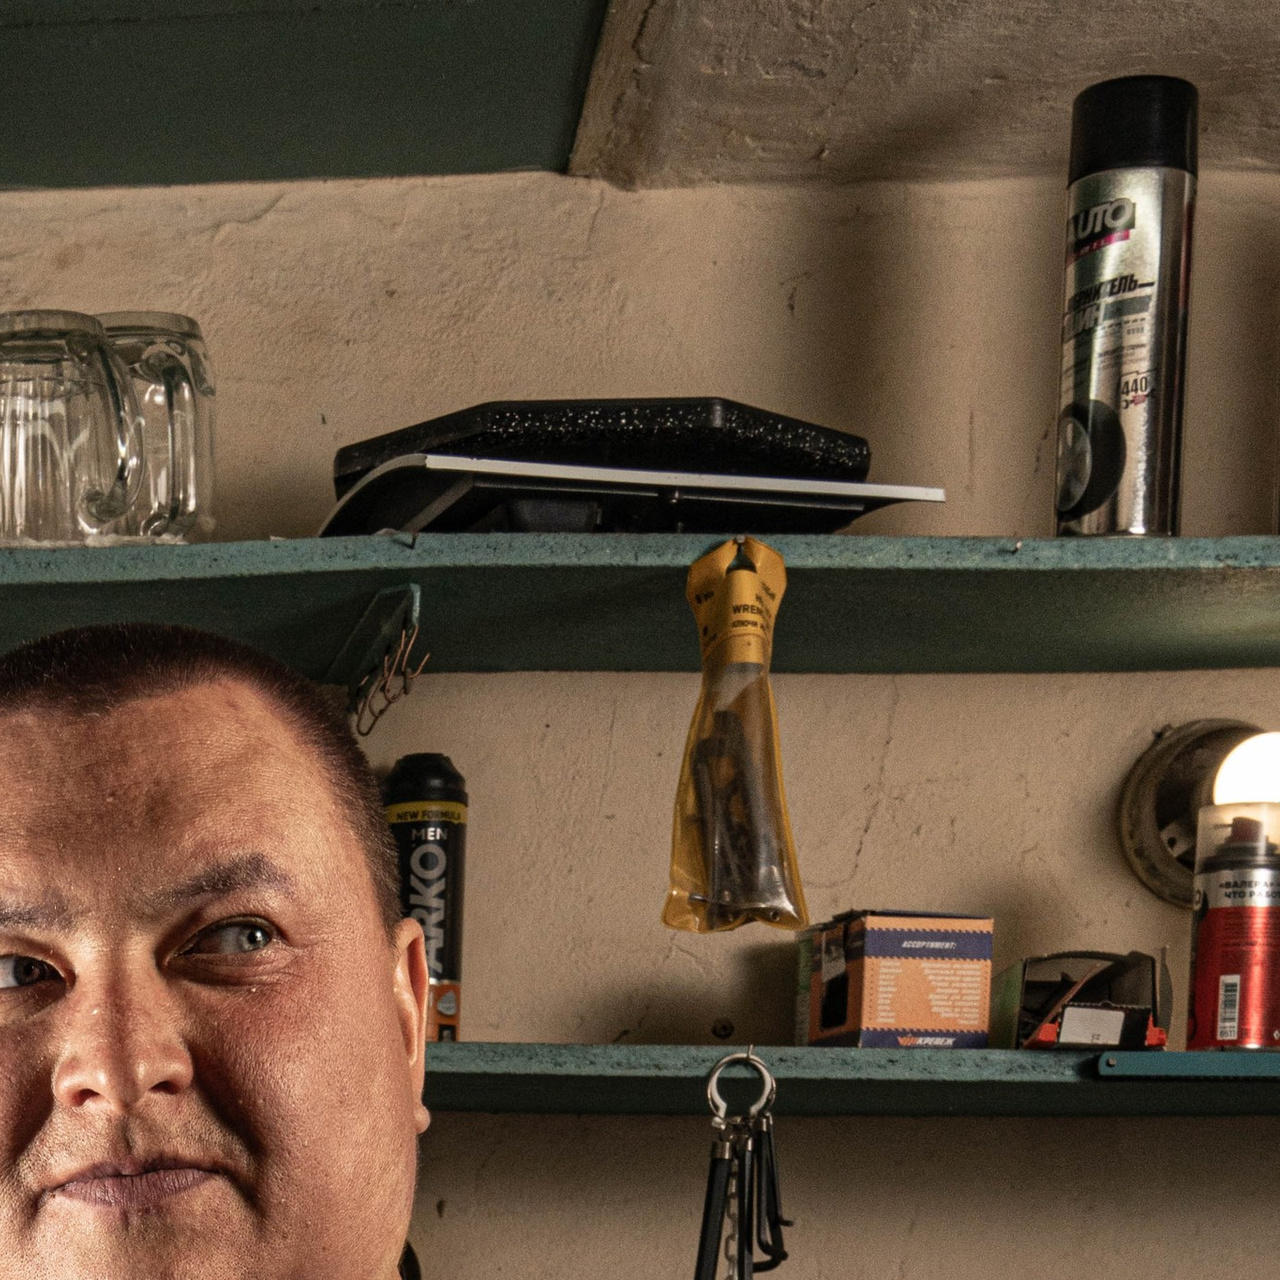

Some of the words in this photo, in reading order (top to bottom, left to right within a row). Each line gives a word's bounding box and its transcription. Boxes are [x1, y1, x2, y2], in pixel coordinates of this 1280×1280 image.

[1121, 376, 1148, 396] 440
[411, 828, 448, 841] MEN
[409, 843, 447, 975] ARKO
